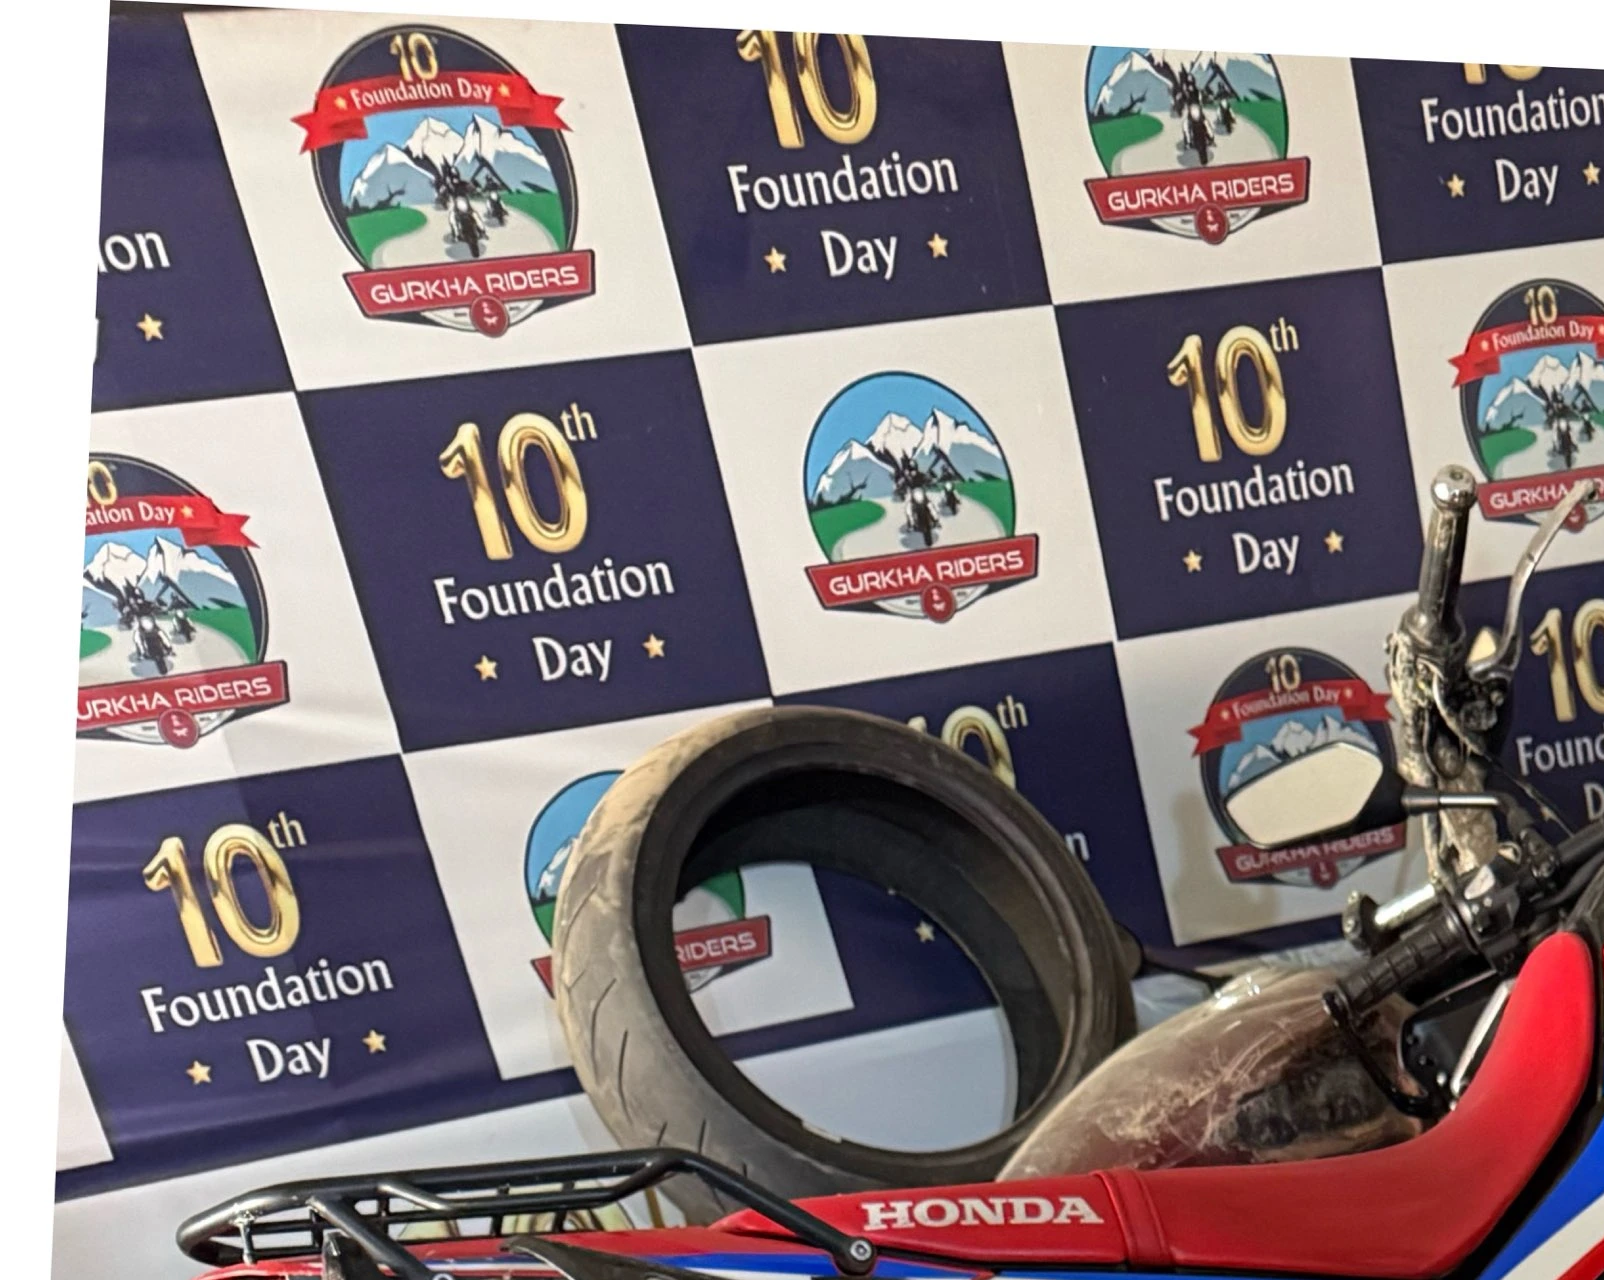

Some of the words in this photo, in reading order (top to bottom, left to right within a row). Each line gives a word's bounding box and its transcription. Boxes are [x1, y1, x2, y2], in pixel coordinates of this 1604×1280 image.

[390, 32, 439, 82] 10
[351, 79, 452, 109] Foundation
[457, 77, 494, 101] Day
[727, 151, 959, 213] Foundation
[1108, 184, 1207, 212] GURKHA
[1211, 173, 1295, 201] RIDERS
[1495, 158, 1559, 206] Day
[820, 229, 897, 281] Day
[370, 276, 481, 305] GURKHA
[486, 265, 580, 294] RIDERS
[1523, 285, 1558, 325] 10
[1492, 325, 1566, 352] Foundation
[1569, 320, 1595, 341] Day
[1166, 316, 1300, 463] 10th
[438, 401, 598, 561] 10th
[1153, 459, 1355, 521] Foundation
[1489, 483, 1569, 510] GURKHA
[138, 500, 176, 525] Day
[829, 564, 932, 596] GURKHA
[937, 550, 1024, 581] RIDERS
[1231, 532, 1300, 575] Day
[433, 557, 675, 625] Foundation
[532, 636, 612, 682] Day
[1265, 653, 1302, 694] 10
[175, 676, 272, 707] RIDERS
[1233, 688, 1311, 720] Foundation
[1313, 684, 1342, 705] Day
[141, 810, 308, 969] 10th
[140, 957, 394, 1034] Foundation
[245, 1036, 332, 1083] Day
[860, 1196, 1105, 1232] HONDA
